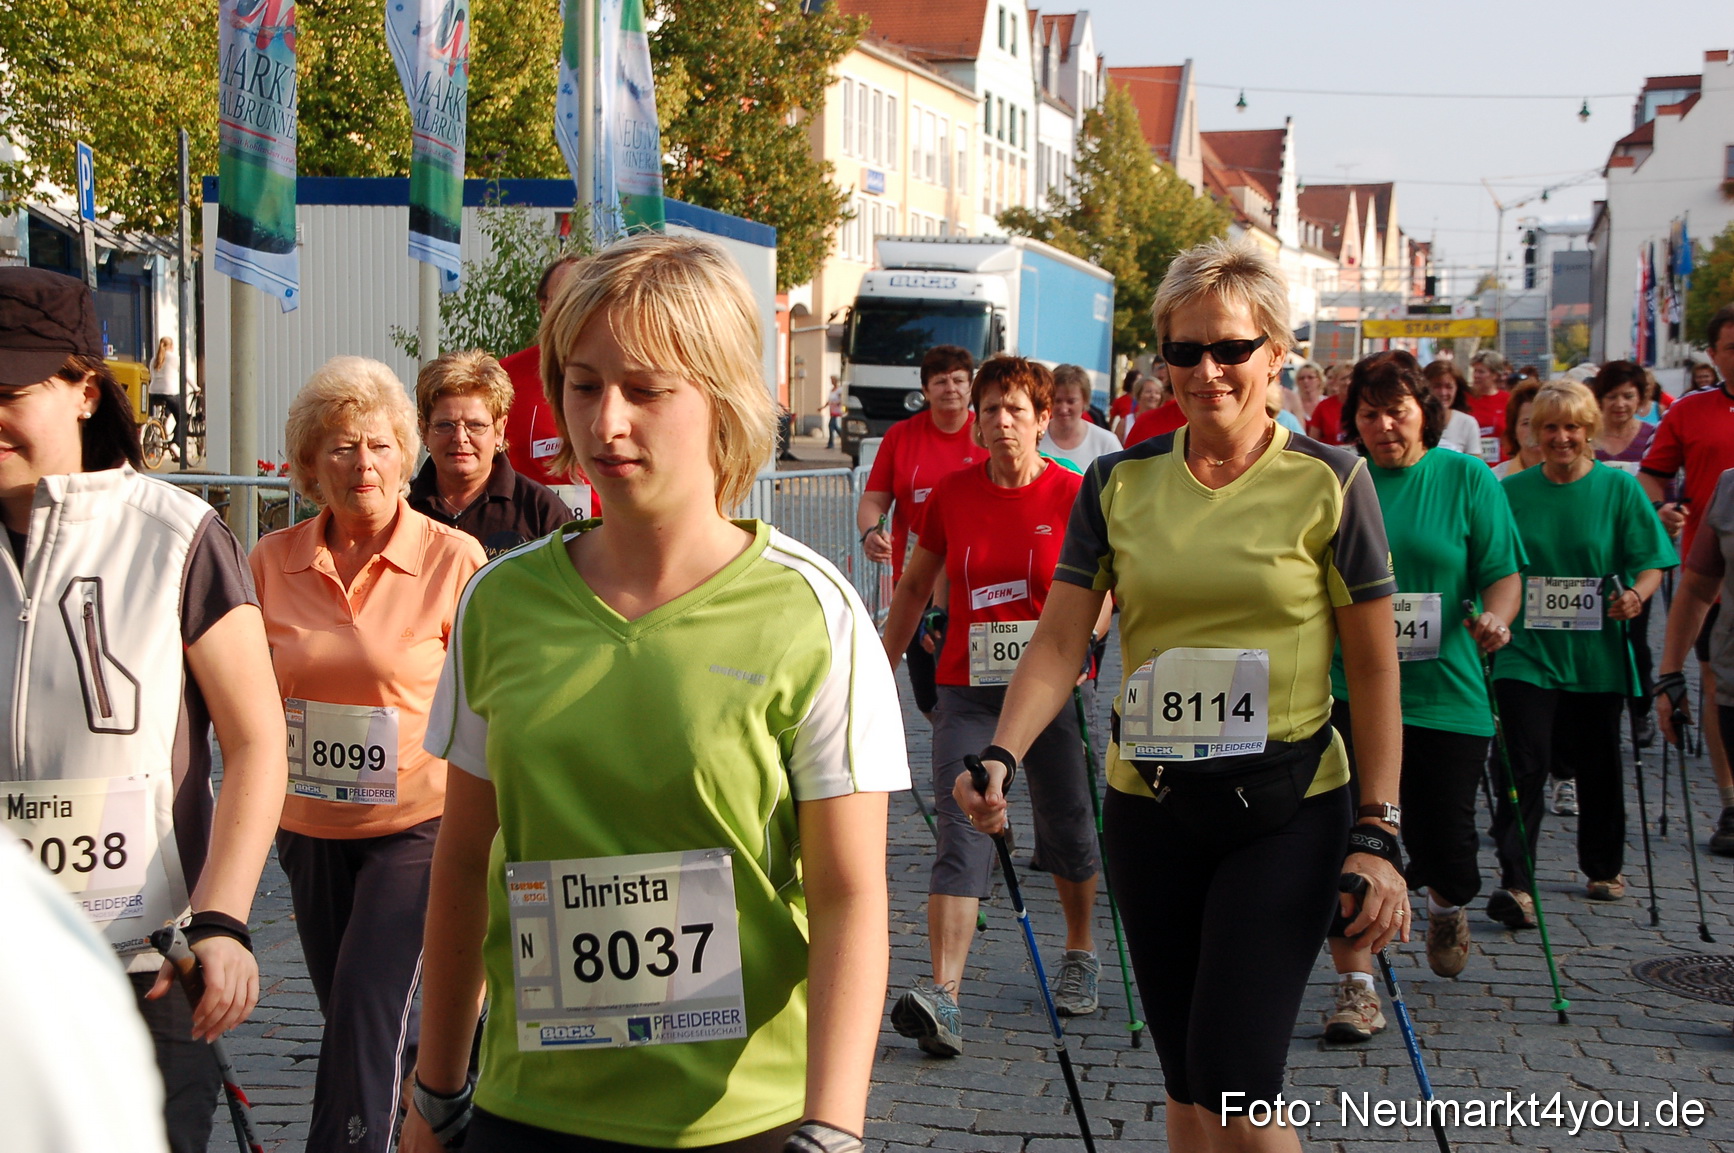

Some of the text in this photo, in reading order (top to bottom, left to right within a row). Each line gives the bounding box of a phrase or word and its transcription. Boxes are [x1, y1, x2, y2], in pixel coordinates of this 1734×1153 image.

[82, 153, 91, 211] P
[889, 274, 958, 289] BOCK
[1405, 322, 1450, 335] START
[987, 587, 1013, 600] DEHN
[1546, 593, 1594, 610] 8040
[1393, 599, 1411, 612] ula
[991, 622, 1018, 633] Rosa
[972, 641, 1030, 661] N 80
[1128, 688, 1255, 723] N 8114
[288, 734, 386, 772] N 8099
[1135, 741, 1263, 755] BOCK PFLEIDERER
[295, 783, 395, 798] BOCK PFLEIDERER
[7, 793, 73, 820] Maria
[20, 832, 128, 875] 038
[562, 873, 669, 909] Christa
[520, 922, 714, 984] N 8037
[540, 1009, 741, 1040] BOCK PFLEIDERER
[654, 1026, 743, 1041] AKTIENGESELLSCHAFT
